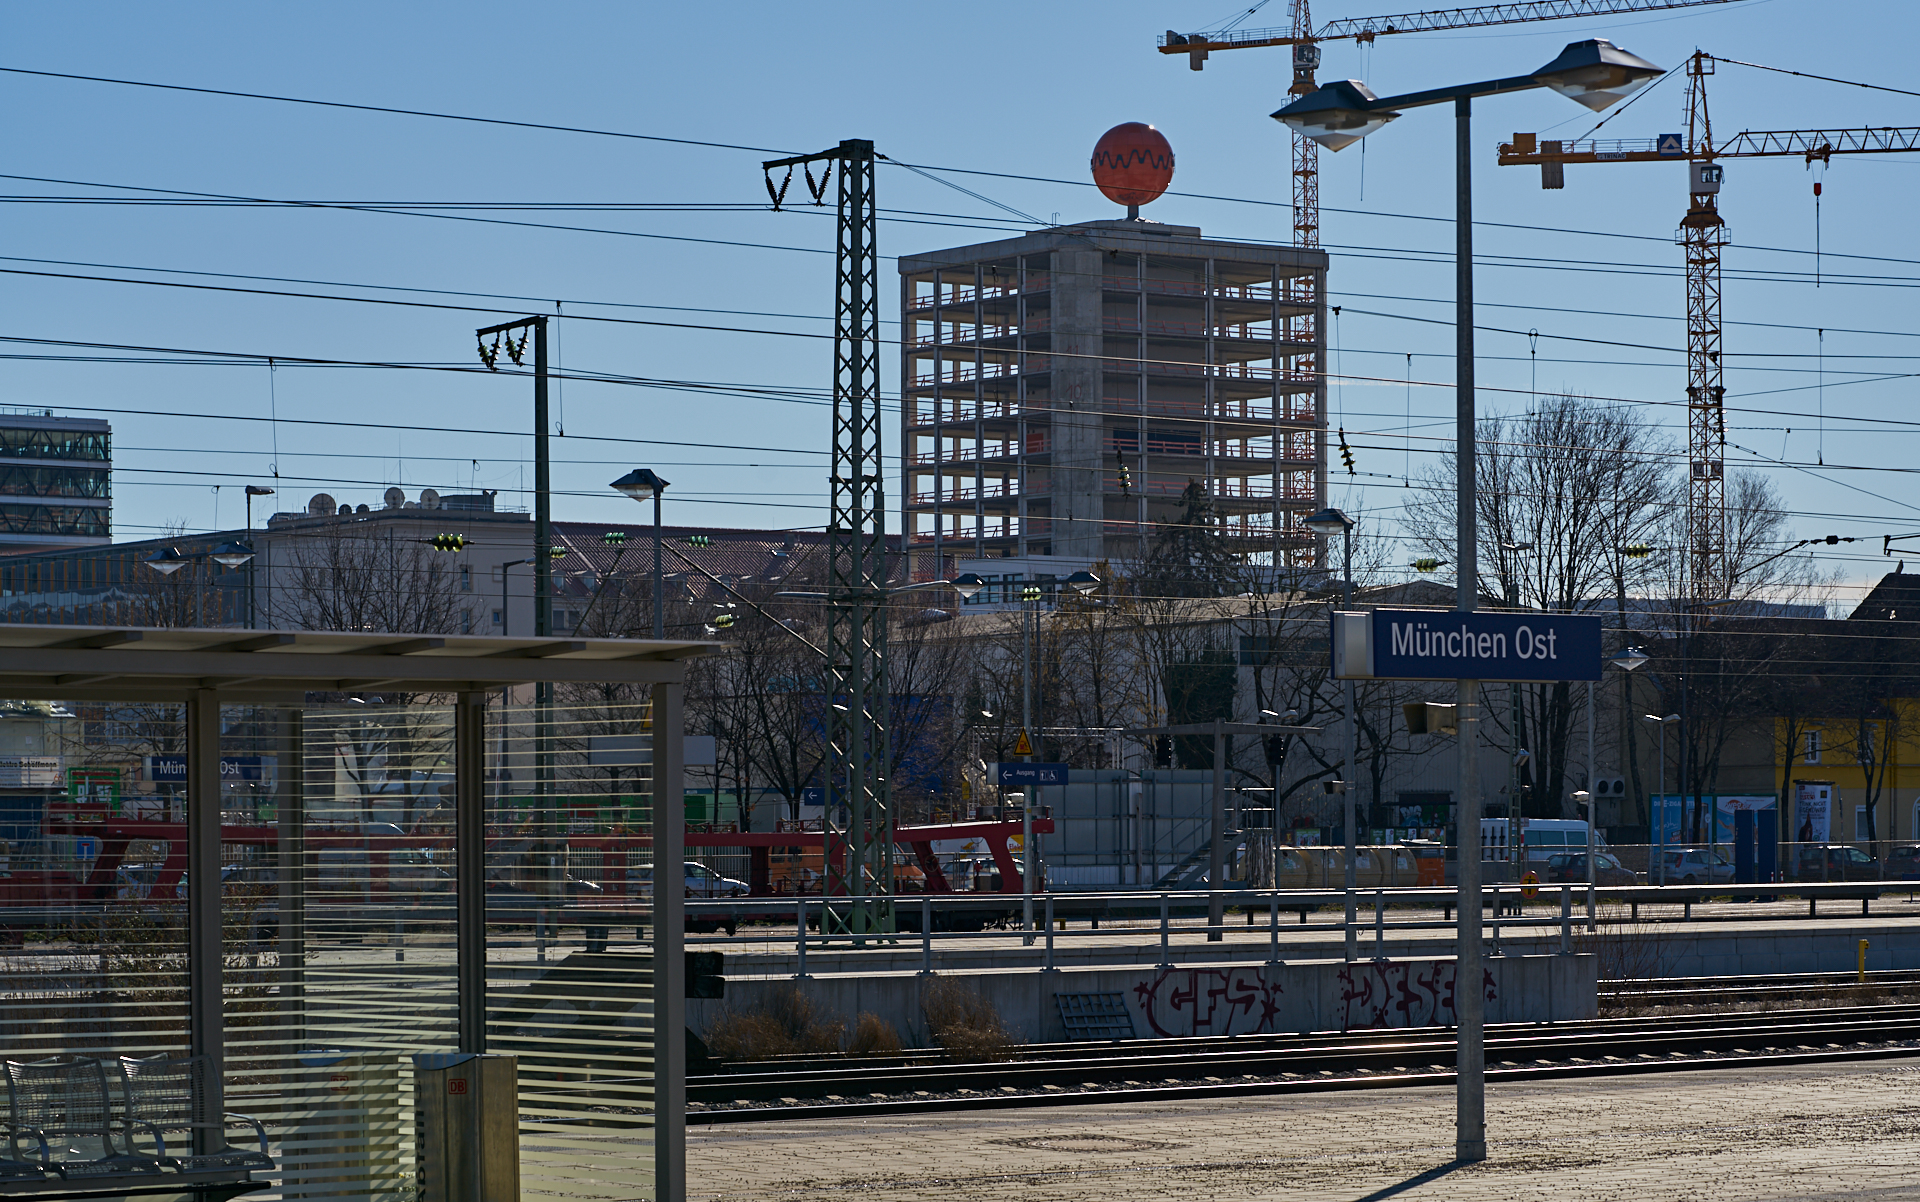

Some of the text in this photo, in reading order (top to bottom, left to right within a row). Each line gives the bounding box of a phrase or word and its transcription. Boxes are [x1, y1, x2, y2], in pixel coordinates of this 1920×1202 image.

[1391, 622, 1557, 660] München Ost
[219, 761, 240, 774] Ost
[1016, 769, 1036, 777] Ausgang
